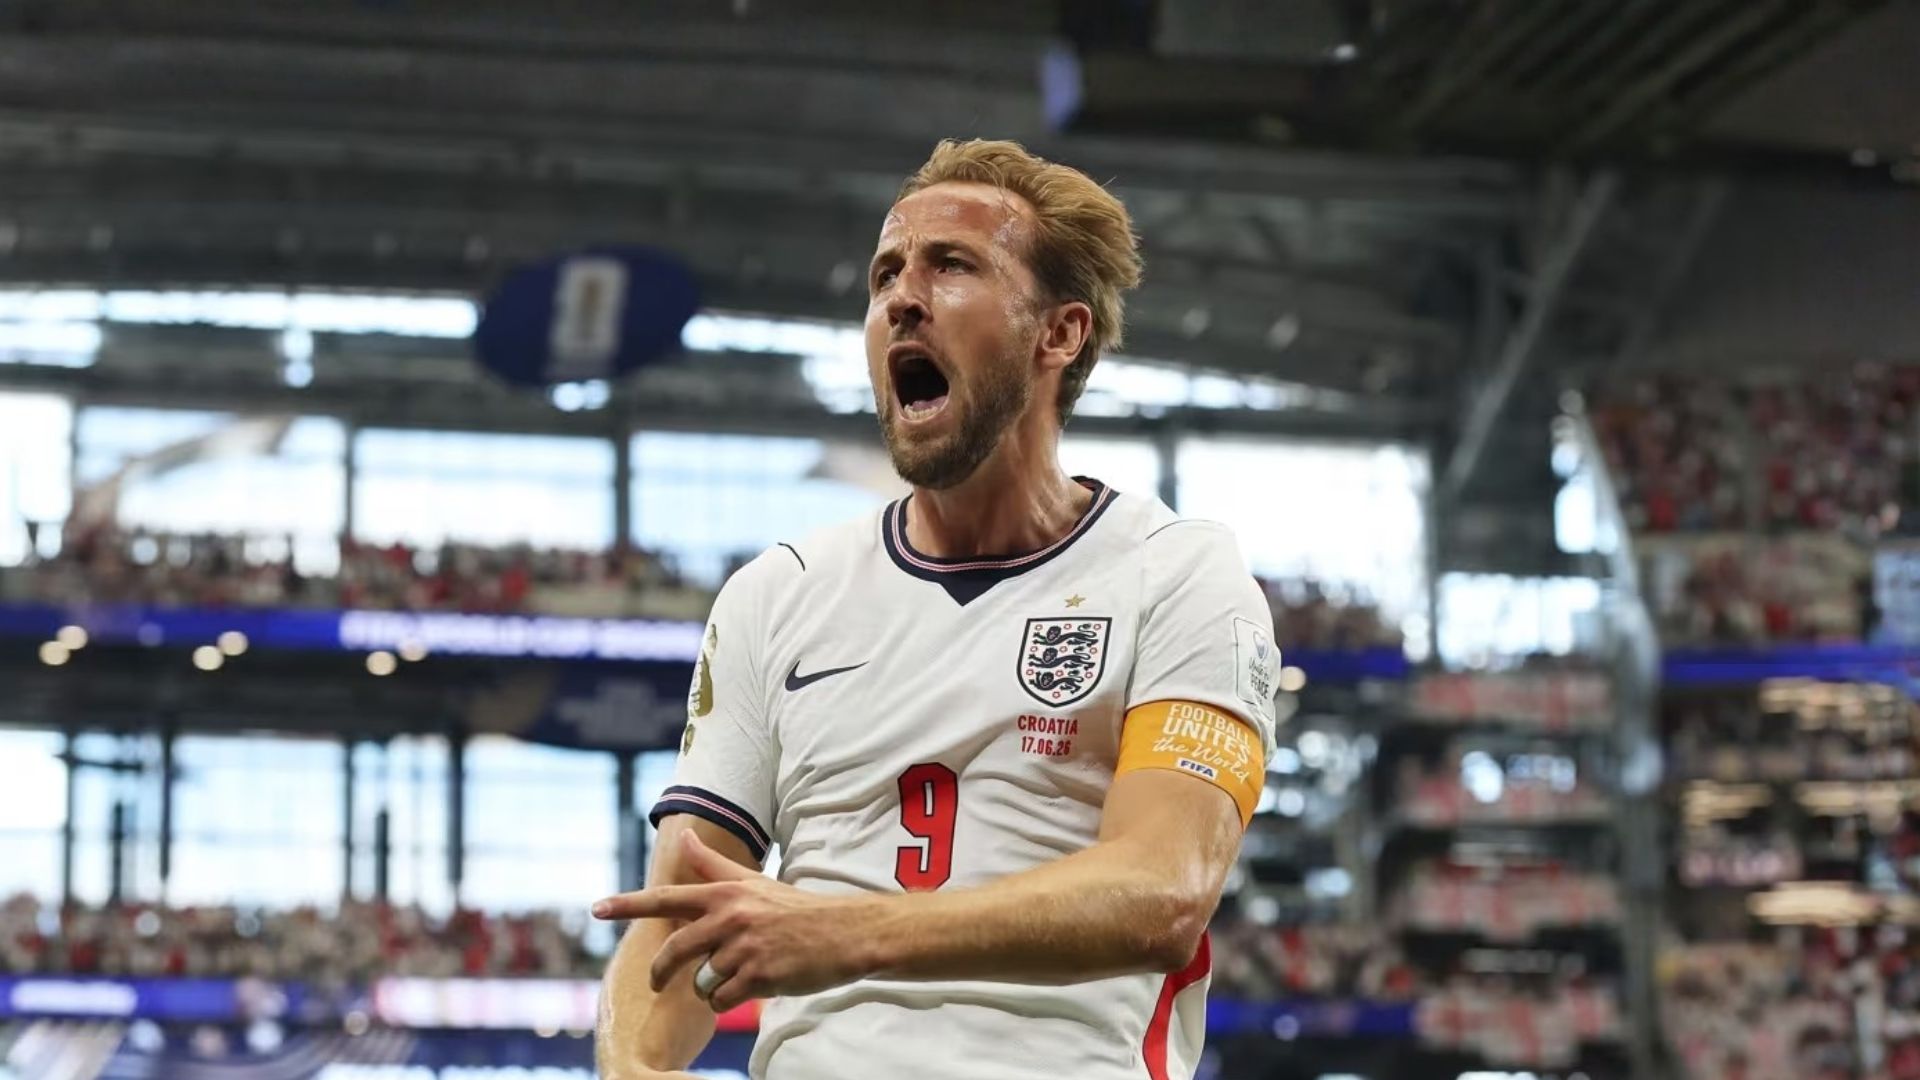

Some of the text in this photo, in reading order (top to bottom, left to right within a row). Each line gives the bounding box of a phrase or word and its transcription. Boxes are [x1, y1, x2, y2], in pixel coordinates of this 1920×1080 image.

[1017, 714, 1078, 735] CROATIA
[1163, 716, 1250, 765] UNITES
[1169, 703, 1250, 744] FOOTBALL
[1021, 735, 1071, 756] 17.06.26
[1152, 737, 1249, 784] the World
[1180, 760, 1214, 777] FIFA
[895, 762, 958, 893] 9
